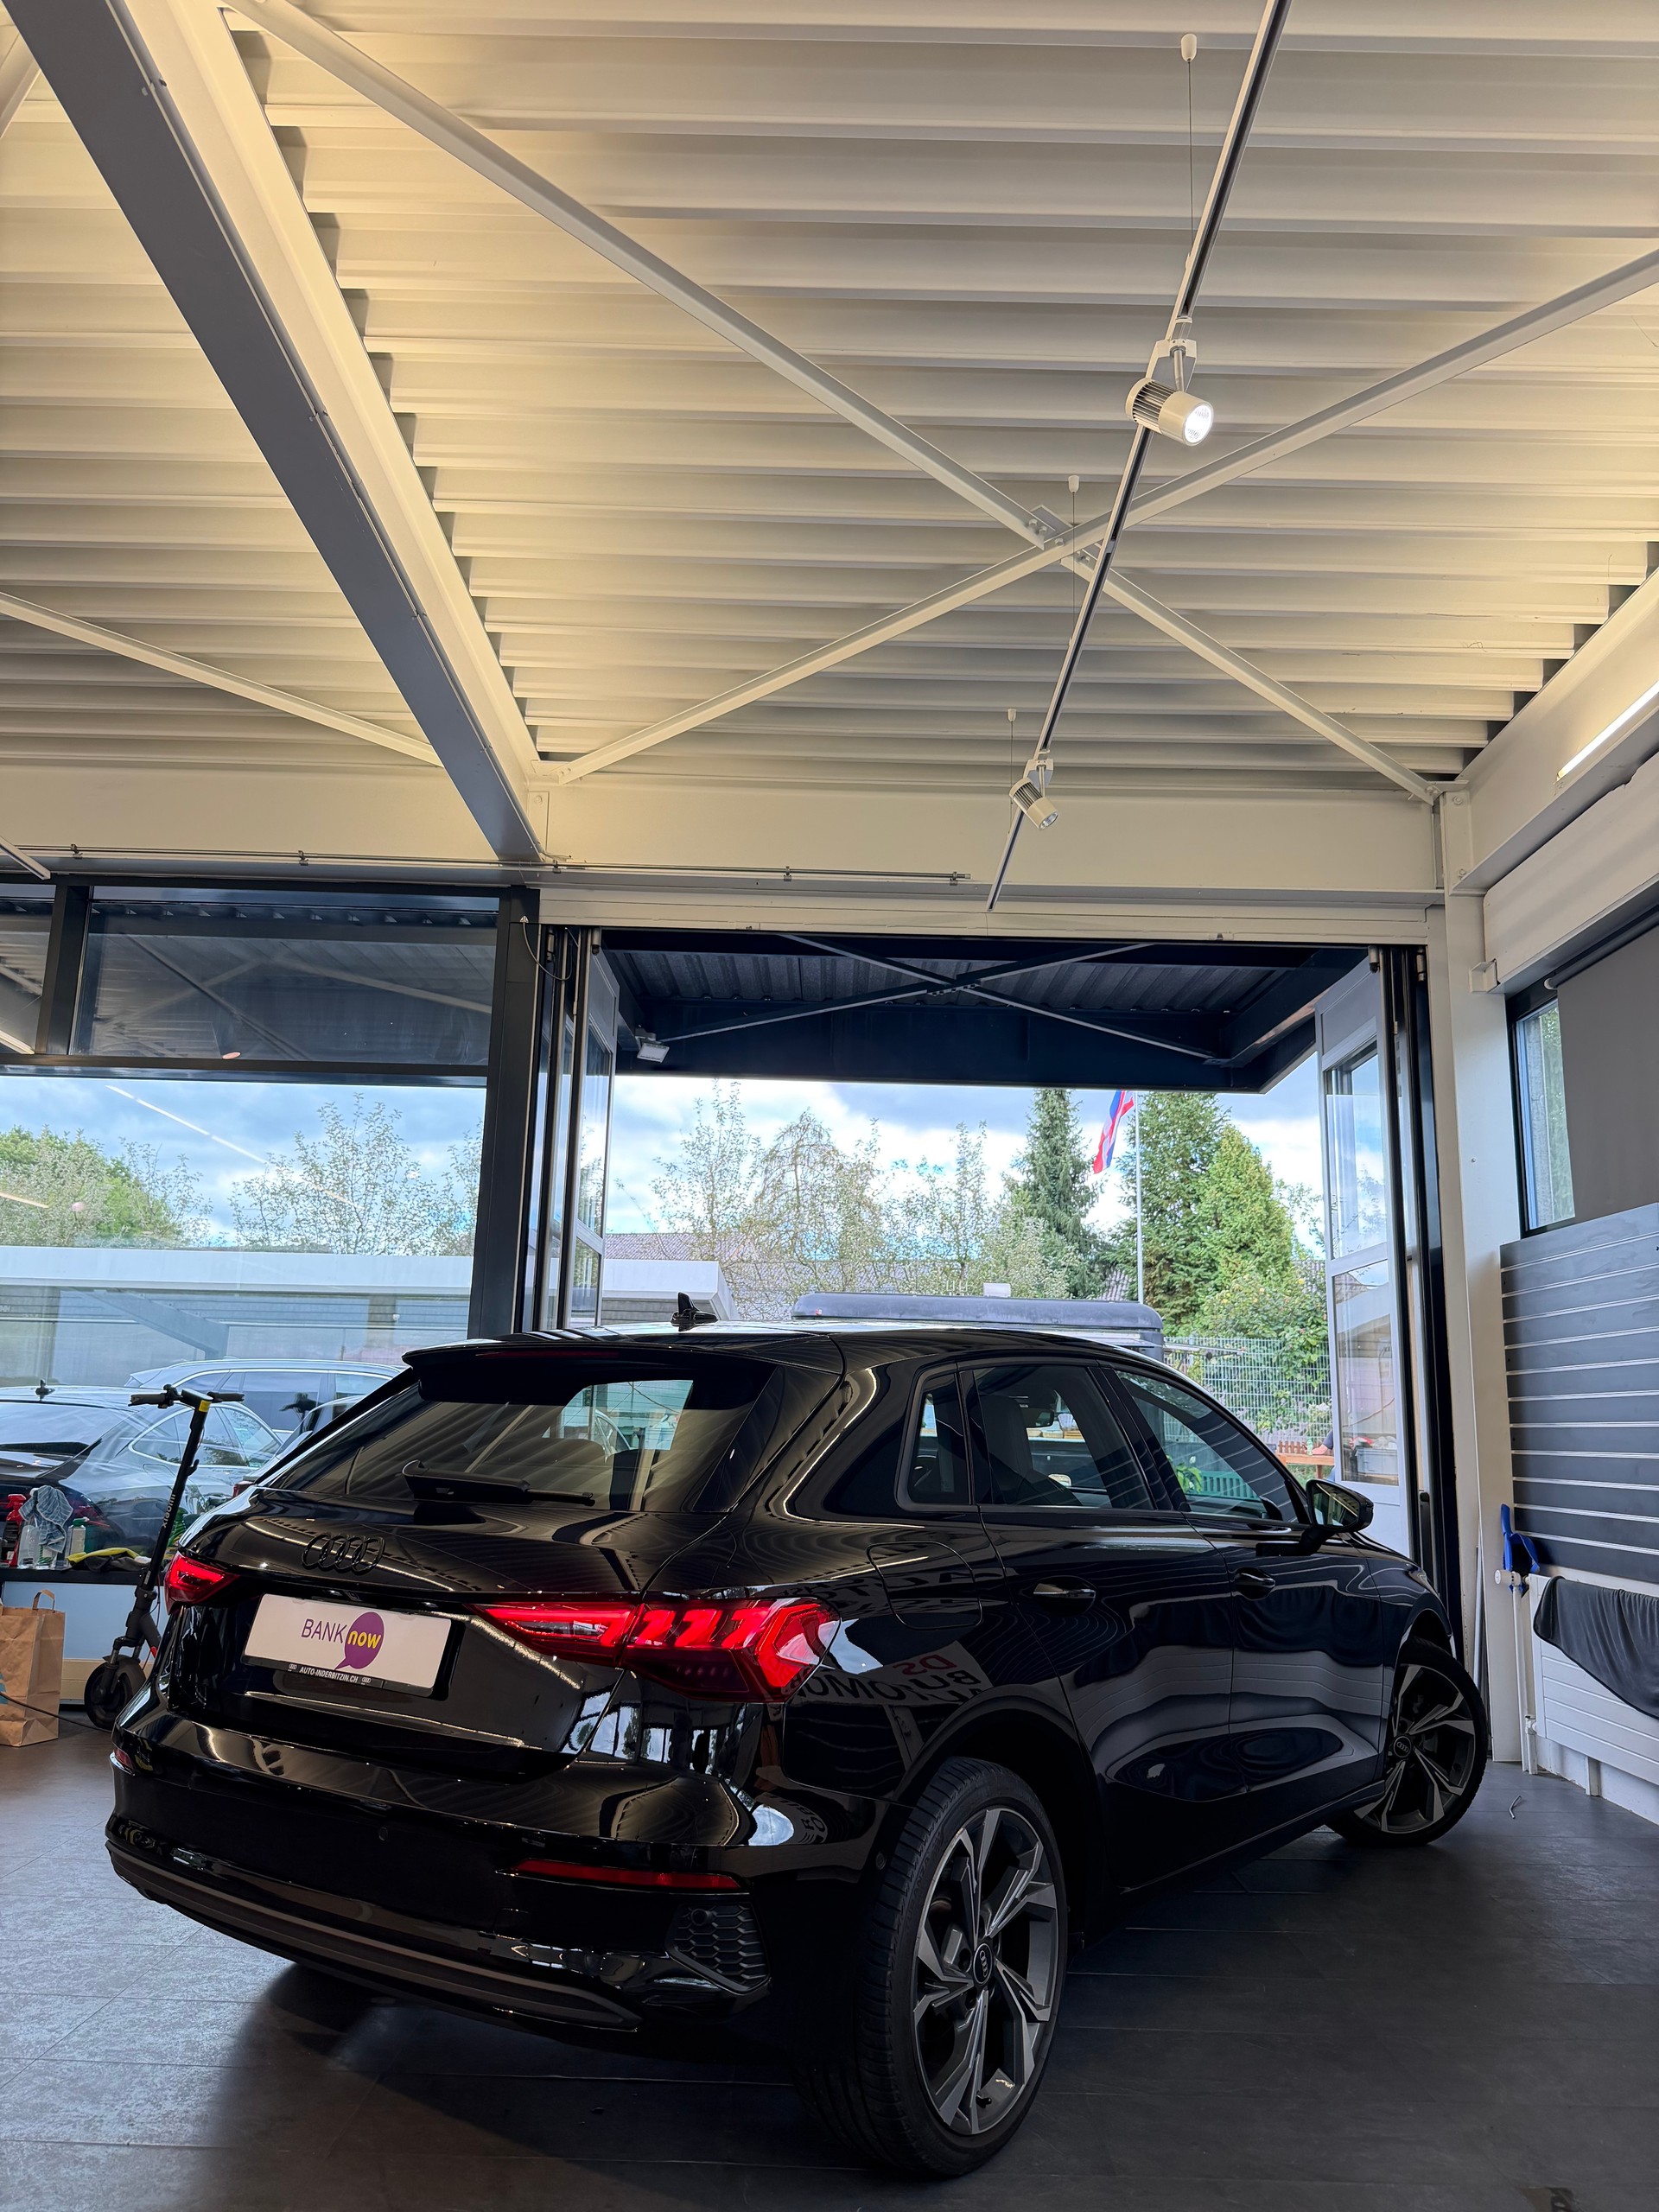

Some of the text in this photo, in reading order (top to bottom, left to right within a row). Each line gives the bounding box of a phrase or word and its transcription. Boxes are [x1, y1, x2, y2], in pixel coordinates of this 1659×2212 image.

[161, 1494, 176, 1529] xiaomi
[301, 1618, 381, 1649] BANK now
[299, 1666, 359, 1683] AUTO-INDERBITZIN.CH
